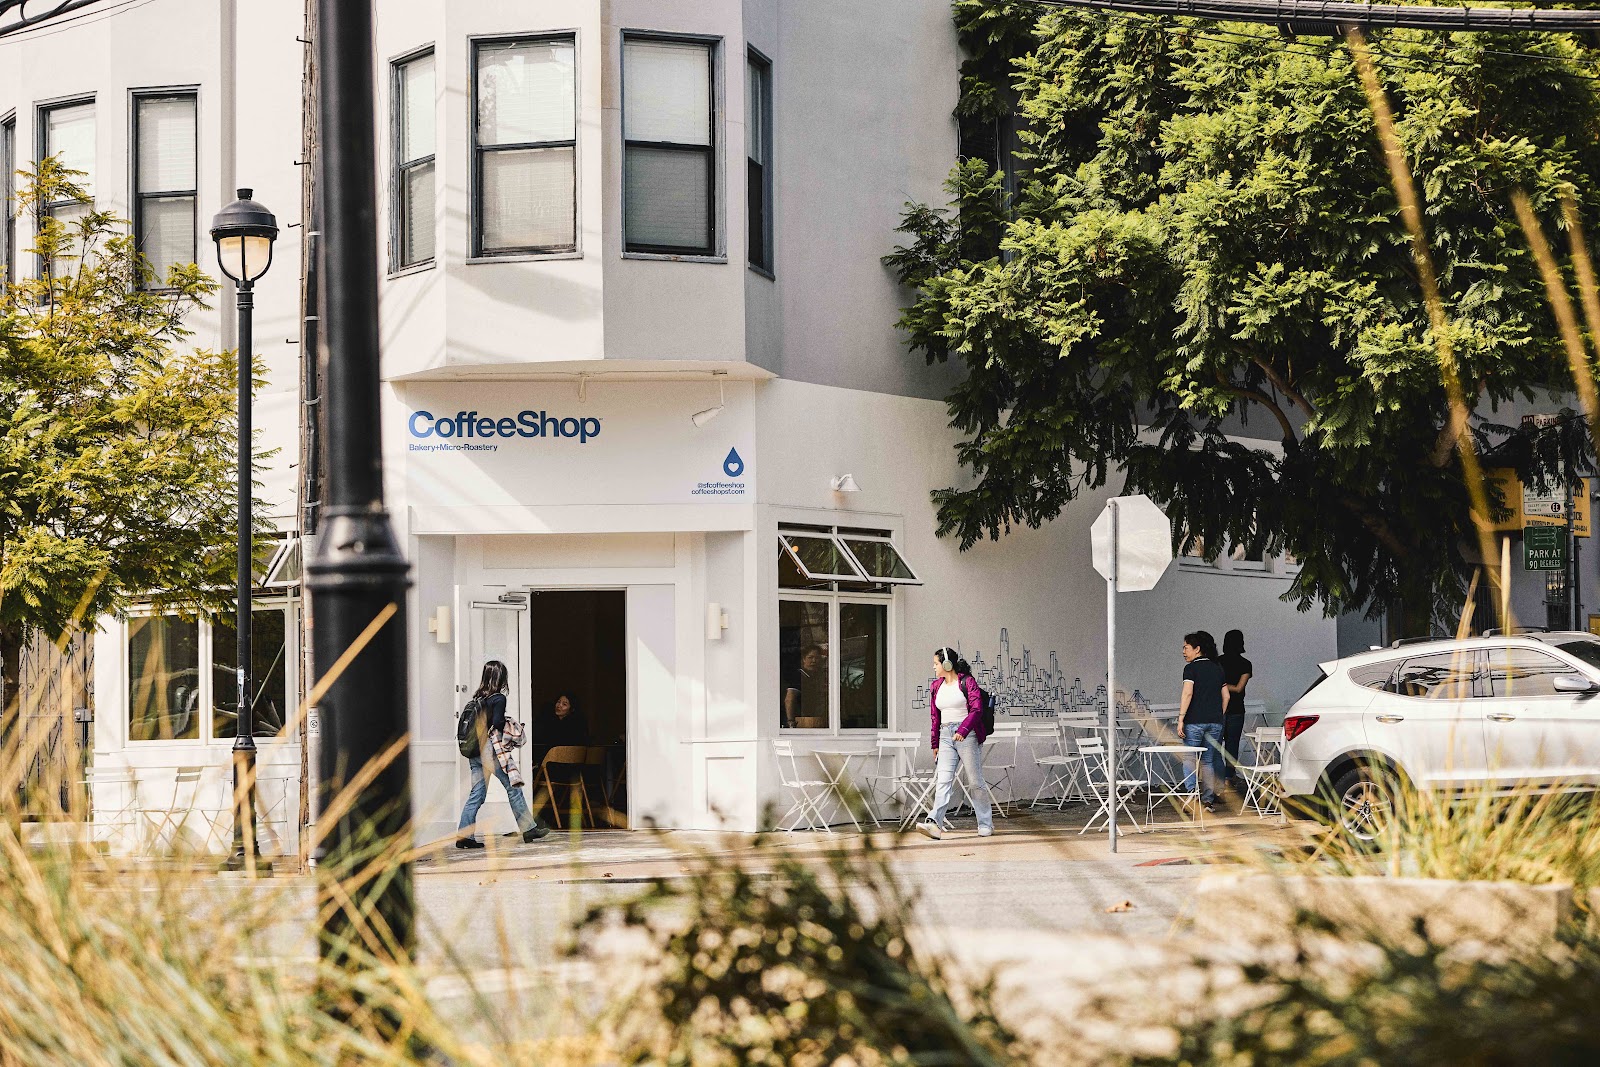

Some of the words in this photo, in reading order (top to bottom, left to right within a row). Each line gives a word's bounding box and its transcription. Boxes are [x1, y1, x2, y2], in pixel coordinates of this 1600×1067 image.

[408, 410, 601, 443] CoffeeShop
[408, 443, 498, 452] Bakery+Micro-Roastery
[1529, 549, 1550, 558] PARK
[1551, 549, 1561, 558] AT
[1529, 560, 1538, 569] 90
